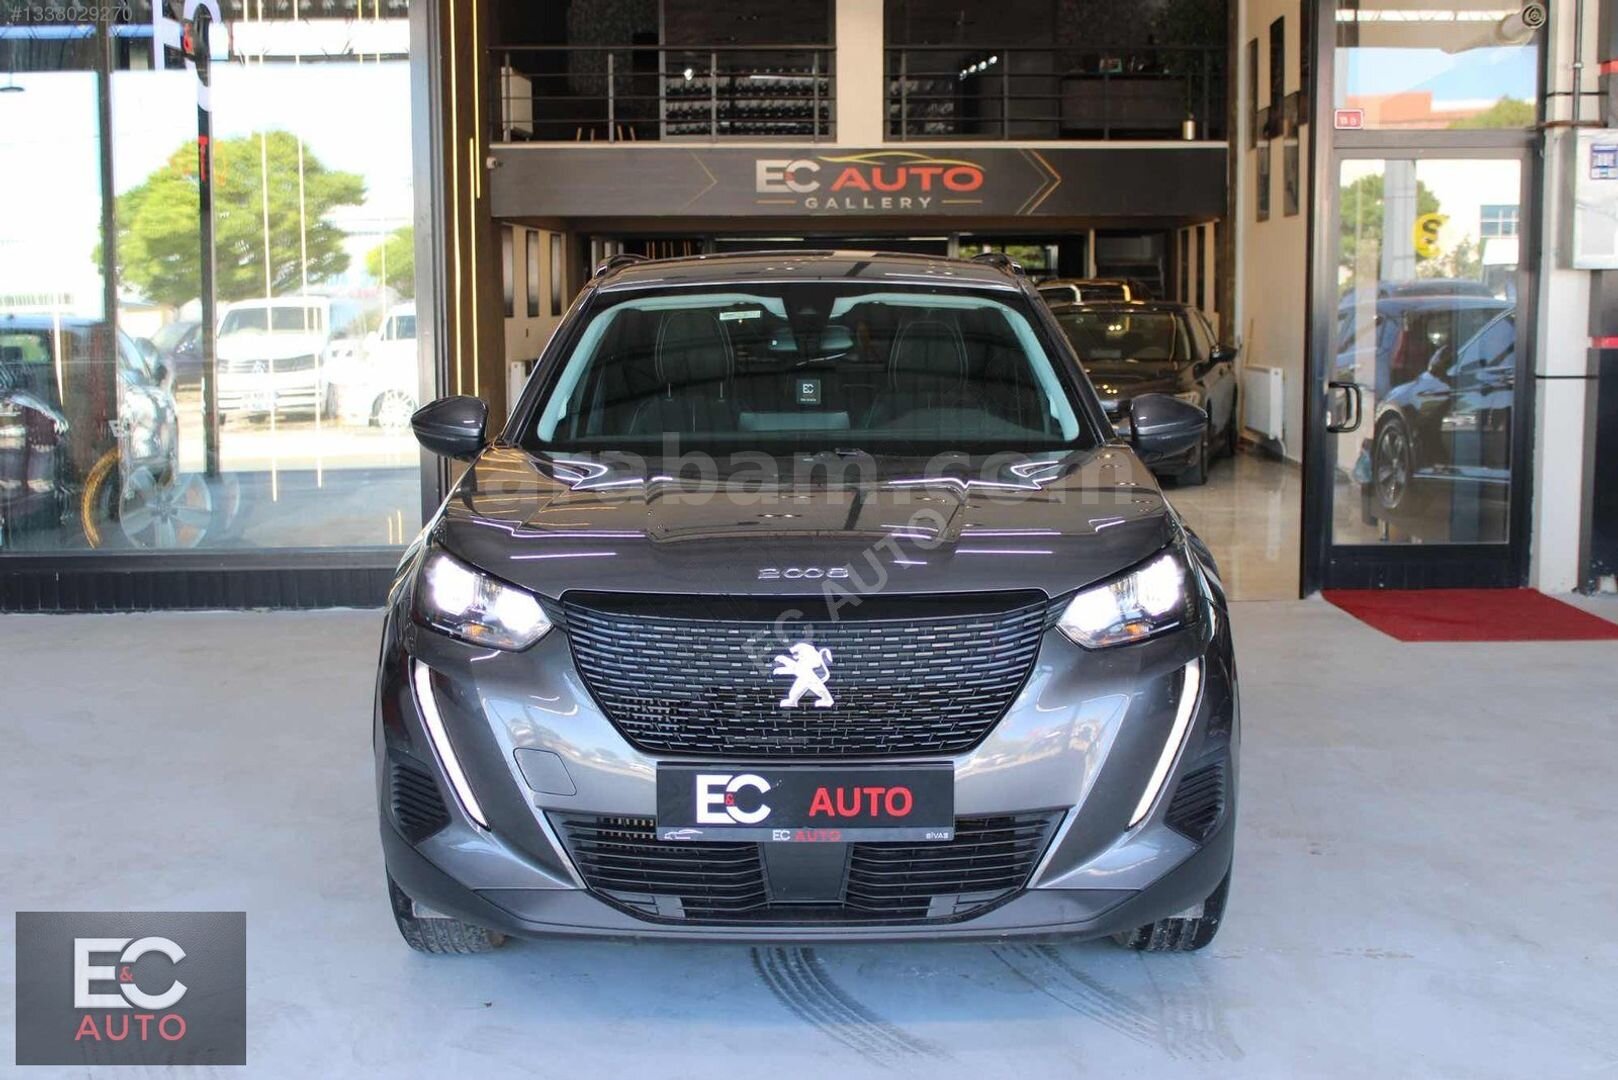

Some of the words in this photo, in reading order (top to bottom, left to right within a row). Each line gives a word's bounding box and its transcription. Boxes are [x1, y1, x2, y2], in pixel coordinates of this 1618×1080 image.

[829, 166, 984, 192] AUTO
[805, 197, 932, 209] GALLERY
[758, 568, 849, 579] 2008
[809, 787, 913, 817] AUTO
[795, 830, 841, 842] AUTO
